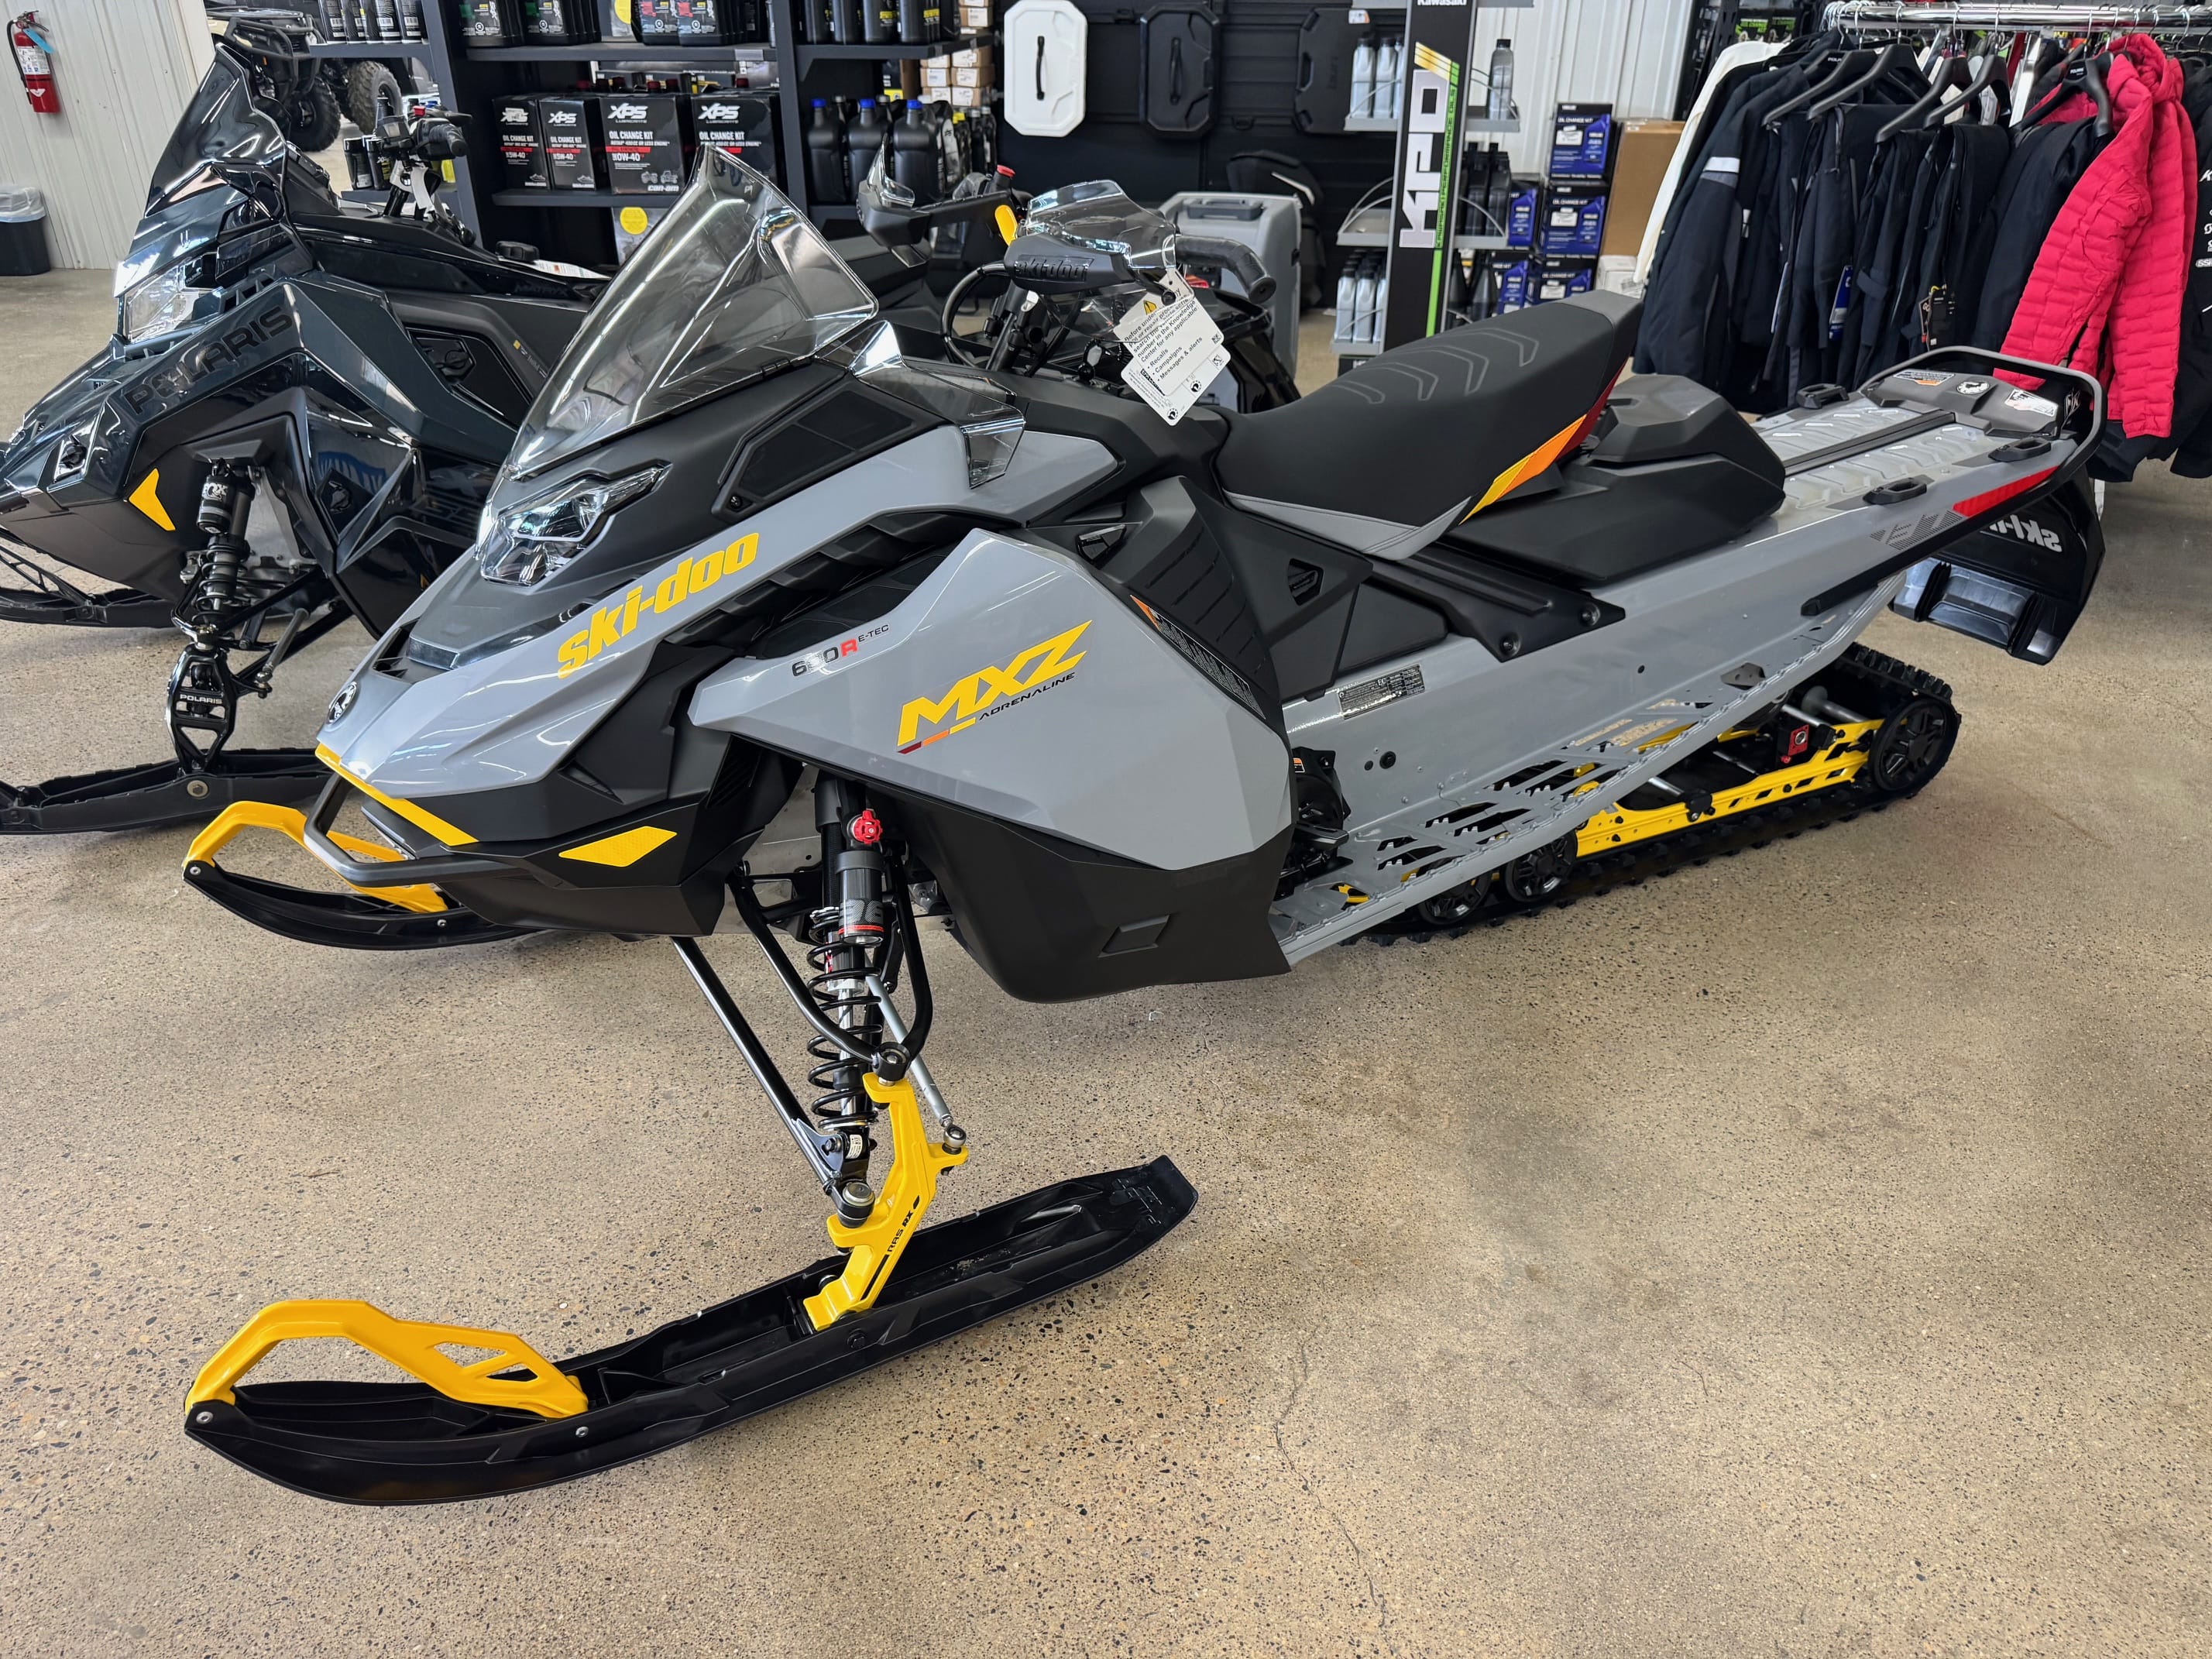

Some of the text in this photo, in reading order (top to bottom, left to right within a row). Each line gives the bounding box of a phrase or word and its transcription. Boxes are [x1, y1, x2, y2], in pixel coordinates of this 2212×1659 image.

[548, 111, 577, 124] XPS
[607, 102, 648, 119] XPS
[698, 102, 740, 120] XPS
[609, 130, 653, 139] OIL CHANGE KIT
[699, 131, 745, 140] OIL CHANGE KIT
[1137, 338, 1156, 358] number
[1161, 325, 1170, 335] the
[1169, 301, 1197, 327] Knowledge
[1133, 335, 1151, 352] search
[1141, 346, 1159, 362] Center
[1156, 338, 1165, 347] for
[1164, 330, 1175, 341] any
[123, 306, 293, 415] POLARIS
[1149, 349, 1169, 367] Recalls
[1155, 346, 1183, 373] Campaigns
[1160, 356, 1184, 380] Messages
[1188, 337, 1203, 352] alerts
[858, 624, 889, 643] E-TEC
[897, 620, 1092, 747] MXZ
[180, 693, 222, 705] POLARIS
[978, 672, 1076, 721] ADRENALINE
[887, 1209, 914, 1252] RAS RX
